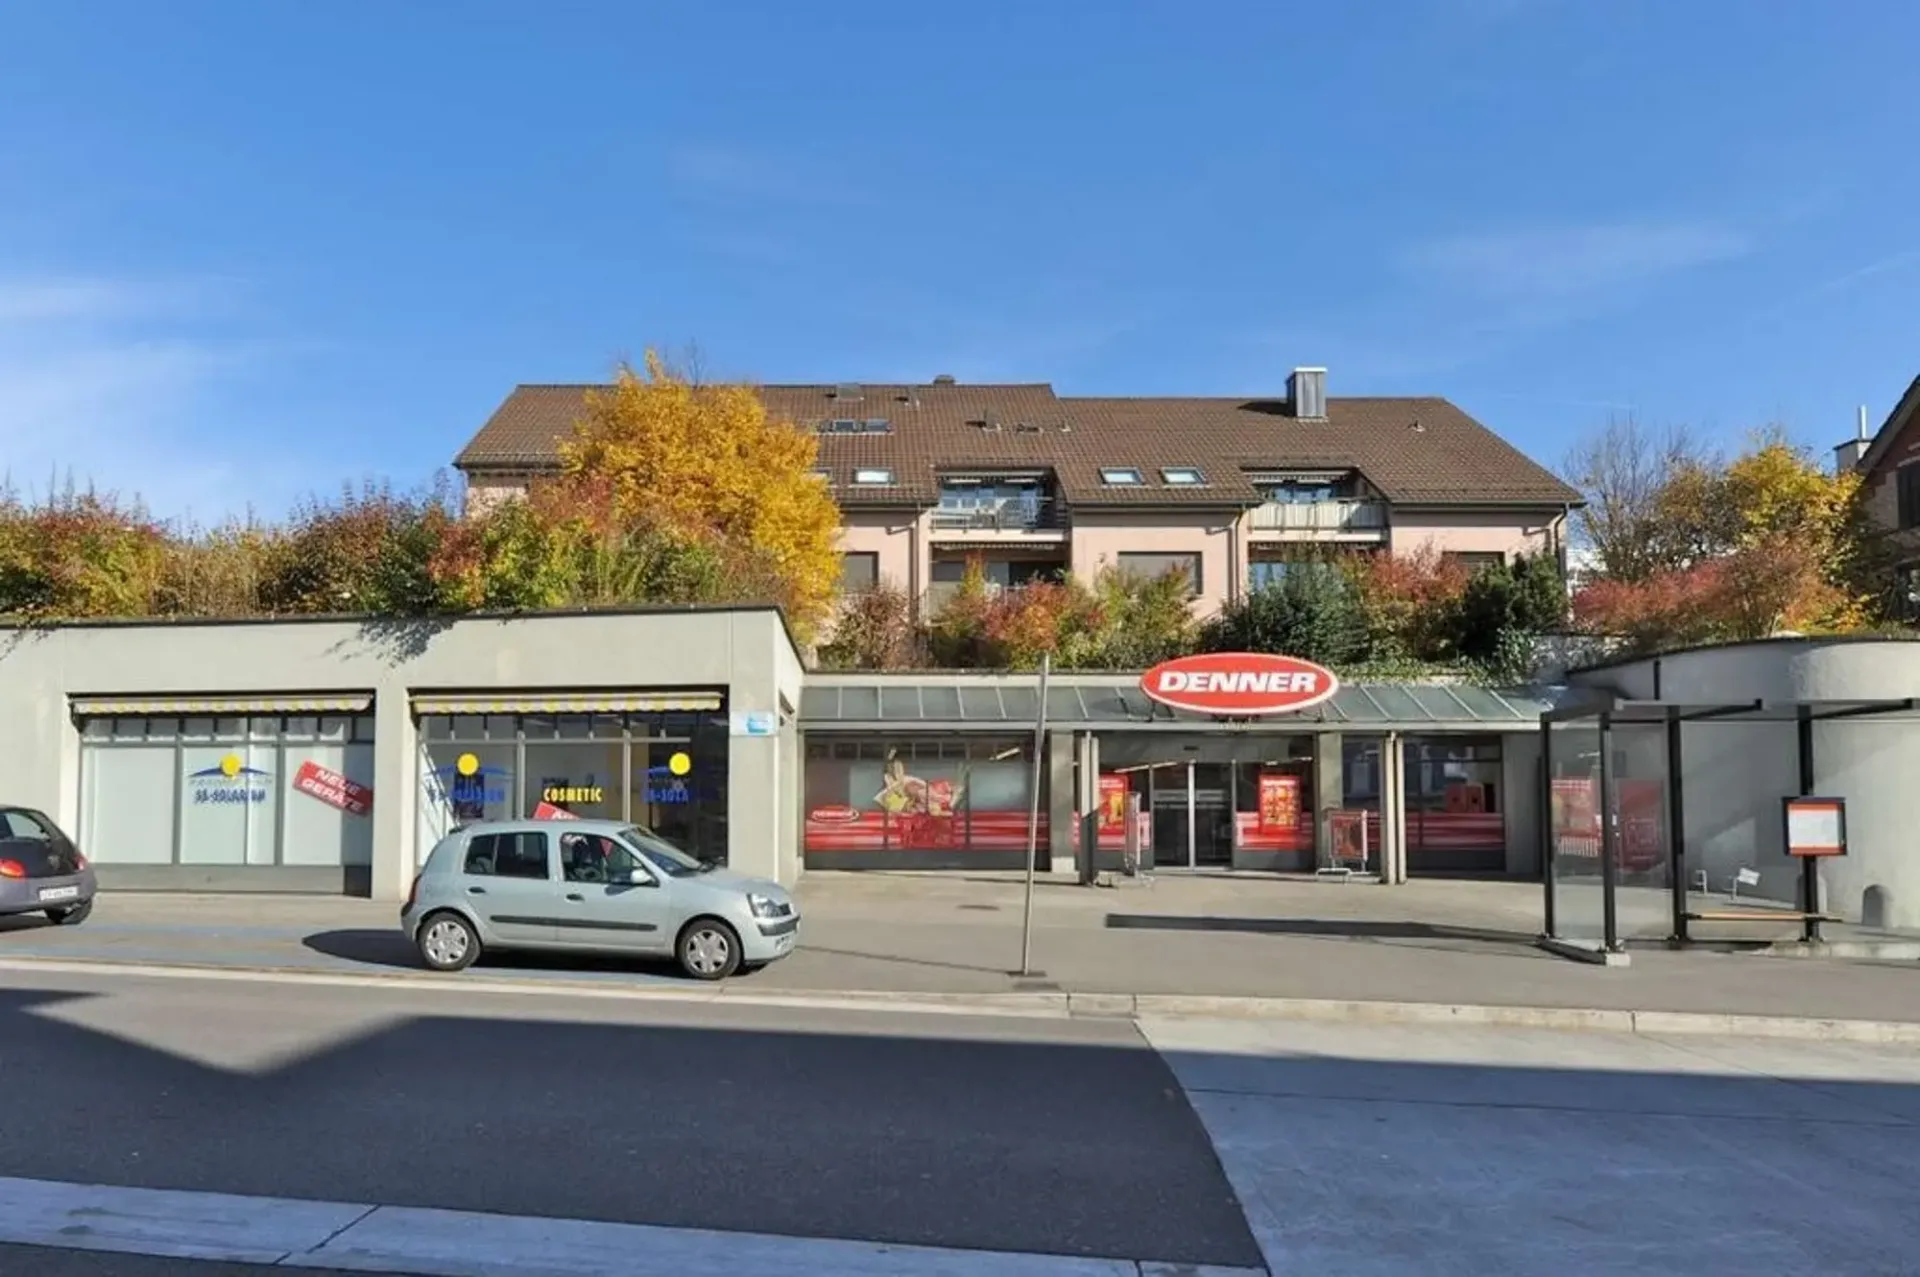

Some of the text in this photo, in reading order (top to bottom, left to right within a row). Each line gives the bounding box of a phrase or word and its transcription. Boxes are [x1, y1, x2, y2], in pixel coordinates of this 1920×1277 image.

[1158, 671, 1317, 693] DENNER
[314, 769, 361, 796] NEUE
[543, 787, 603, 802] COSMETIC
